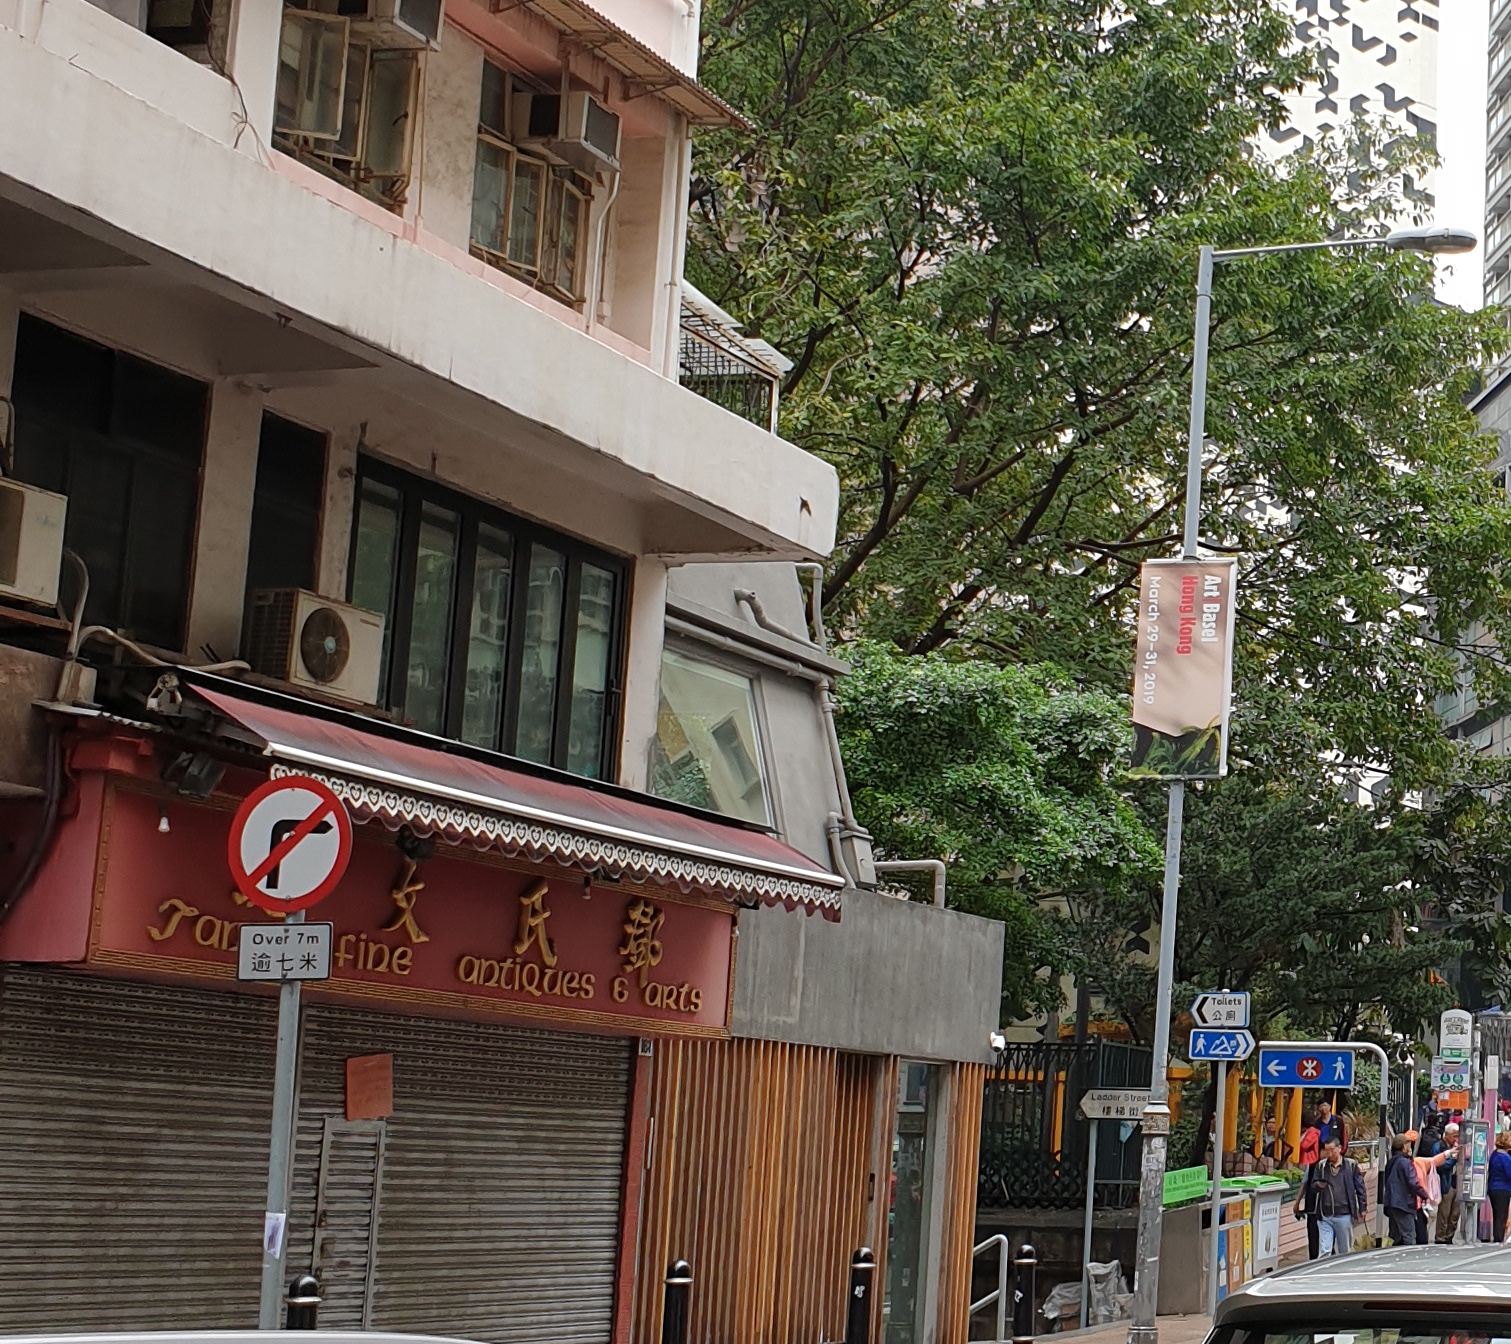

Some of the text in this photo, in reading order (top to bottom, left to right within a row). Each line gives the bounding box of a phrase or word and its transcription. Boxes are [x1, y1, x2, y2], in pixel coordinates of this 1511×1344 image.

[1148, 576, 1162, 622] March
[1177, 576, 1198, 654] Hong Kong
[1200, 575, 1222, 643] Art Basel
[1143, 672, 1156, 705] 2019
[252, 932, 320, 946] Over 7m
[251, 951, 317, 973] 逾七米
[335, 933, 413, 975] fine
[458, 955, 596, 999] antiques
[645, 982, 703, 1012] arts
[1211, 996, 1242, 1006] Toilets
[1091, 1092, 1151, 1102] Ladder Street
